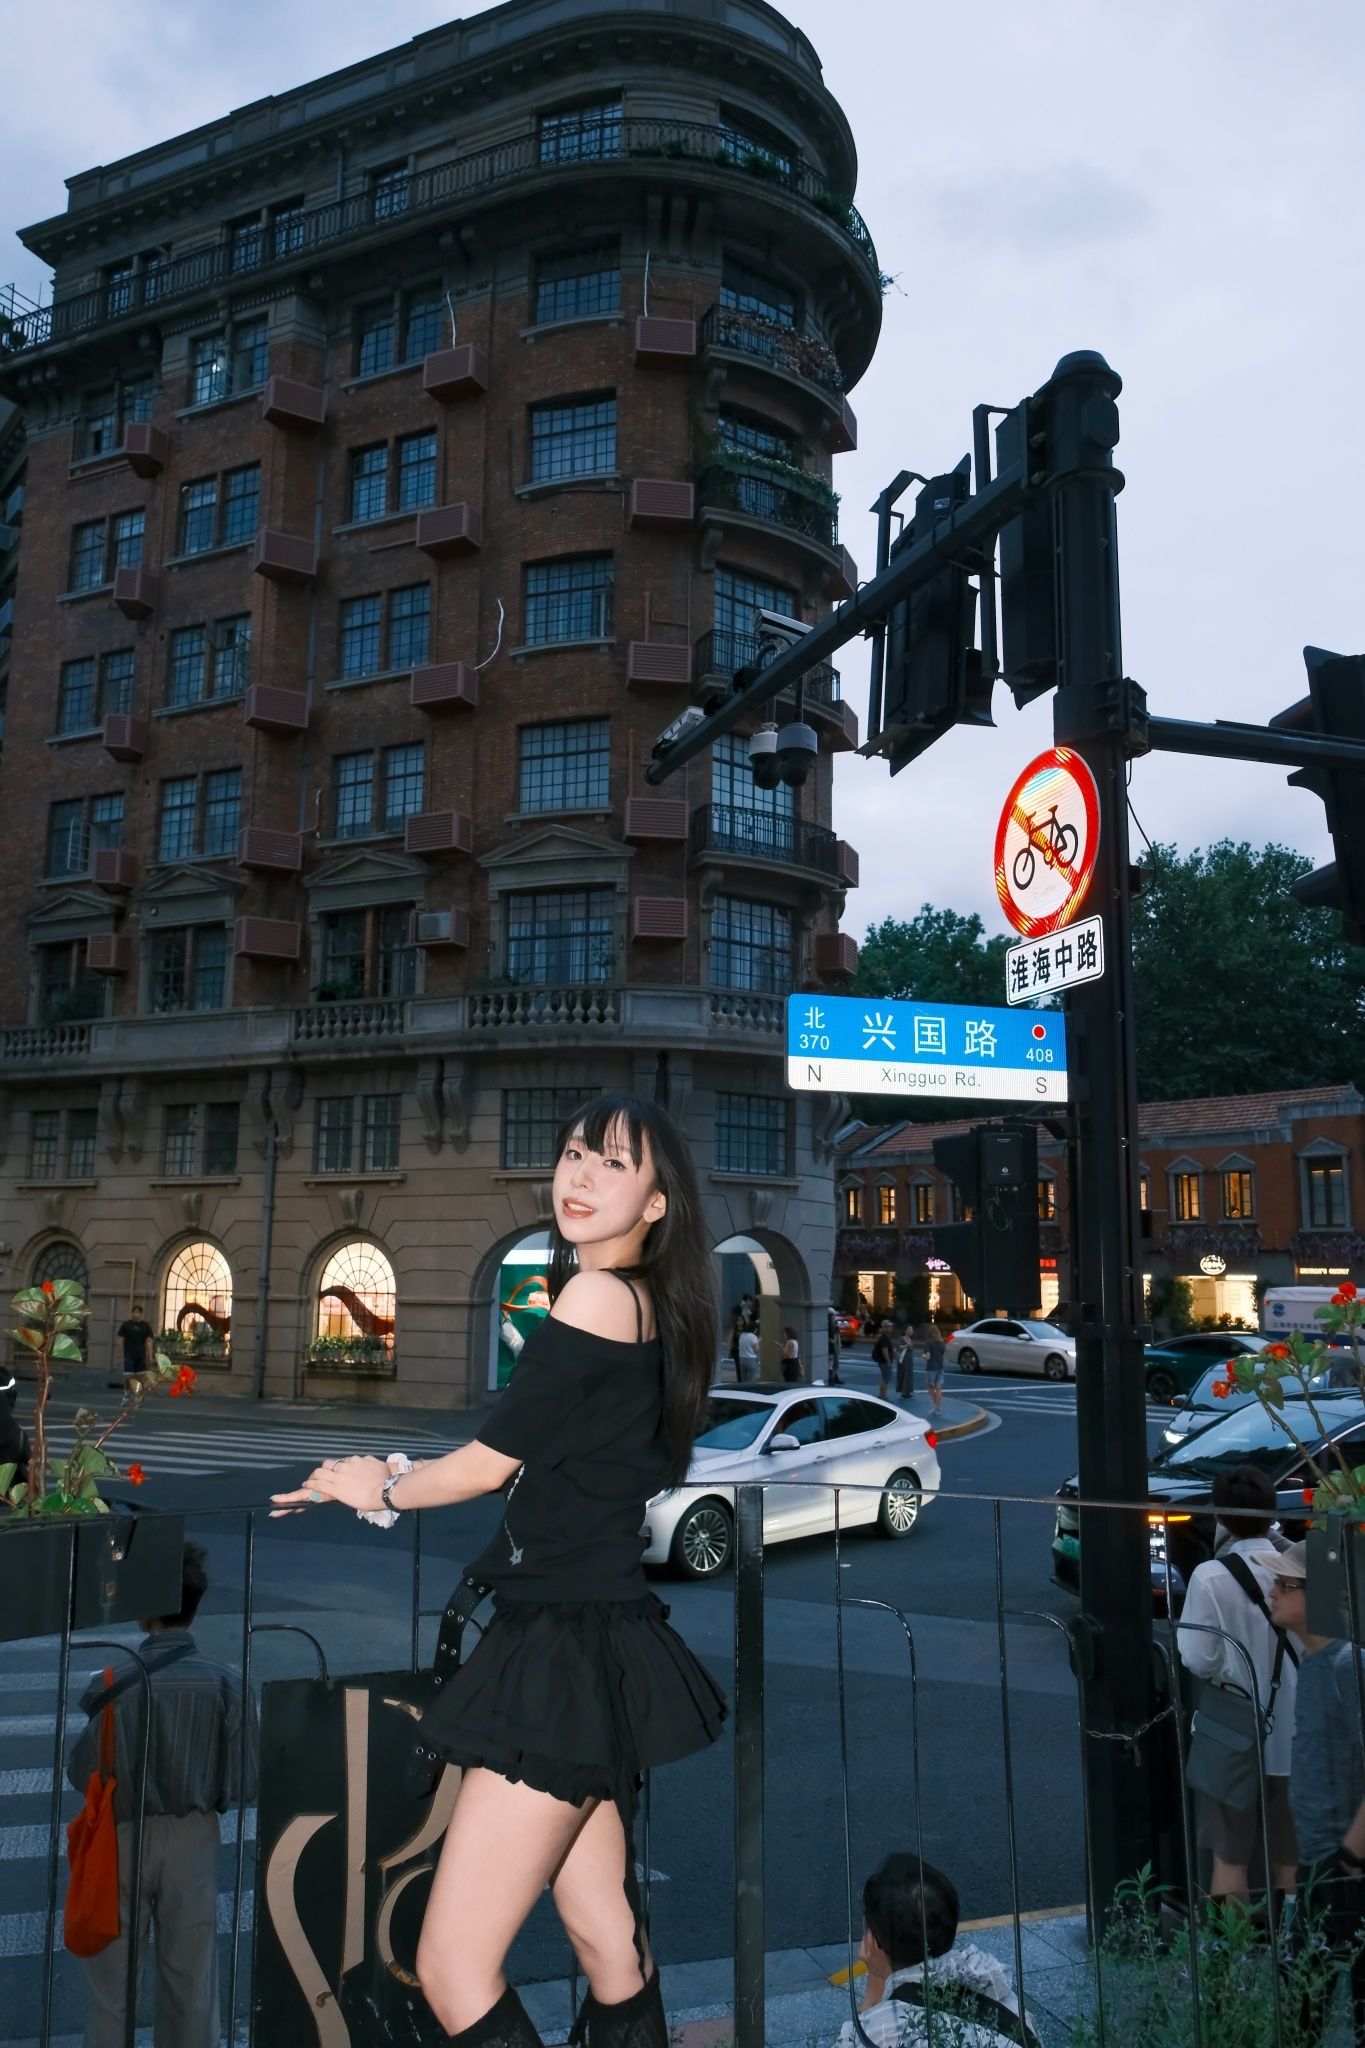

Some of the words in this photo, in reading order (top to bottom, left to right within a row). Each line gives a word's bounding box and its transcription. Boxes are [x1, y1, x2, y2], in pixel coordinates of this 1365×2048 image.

[1011, 929, 1098, 993] 淮海中路
[804, 1007, 825, 1029] 北
[799, 1034, 830, 1050] 370
[862, 1012, 998, 1057] 兴国路
[1026, 1048, 1054, 1063] 408
[808, 1065, 822, 1083] N
[881, 1068, 947, 1088] Xingguo
[955, 1071, 981, 1087] Rd.
[1035, 1077, 1048, 1094] S
